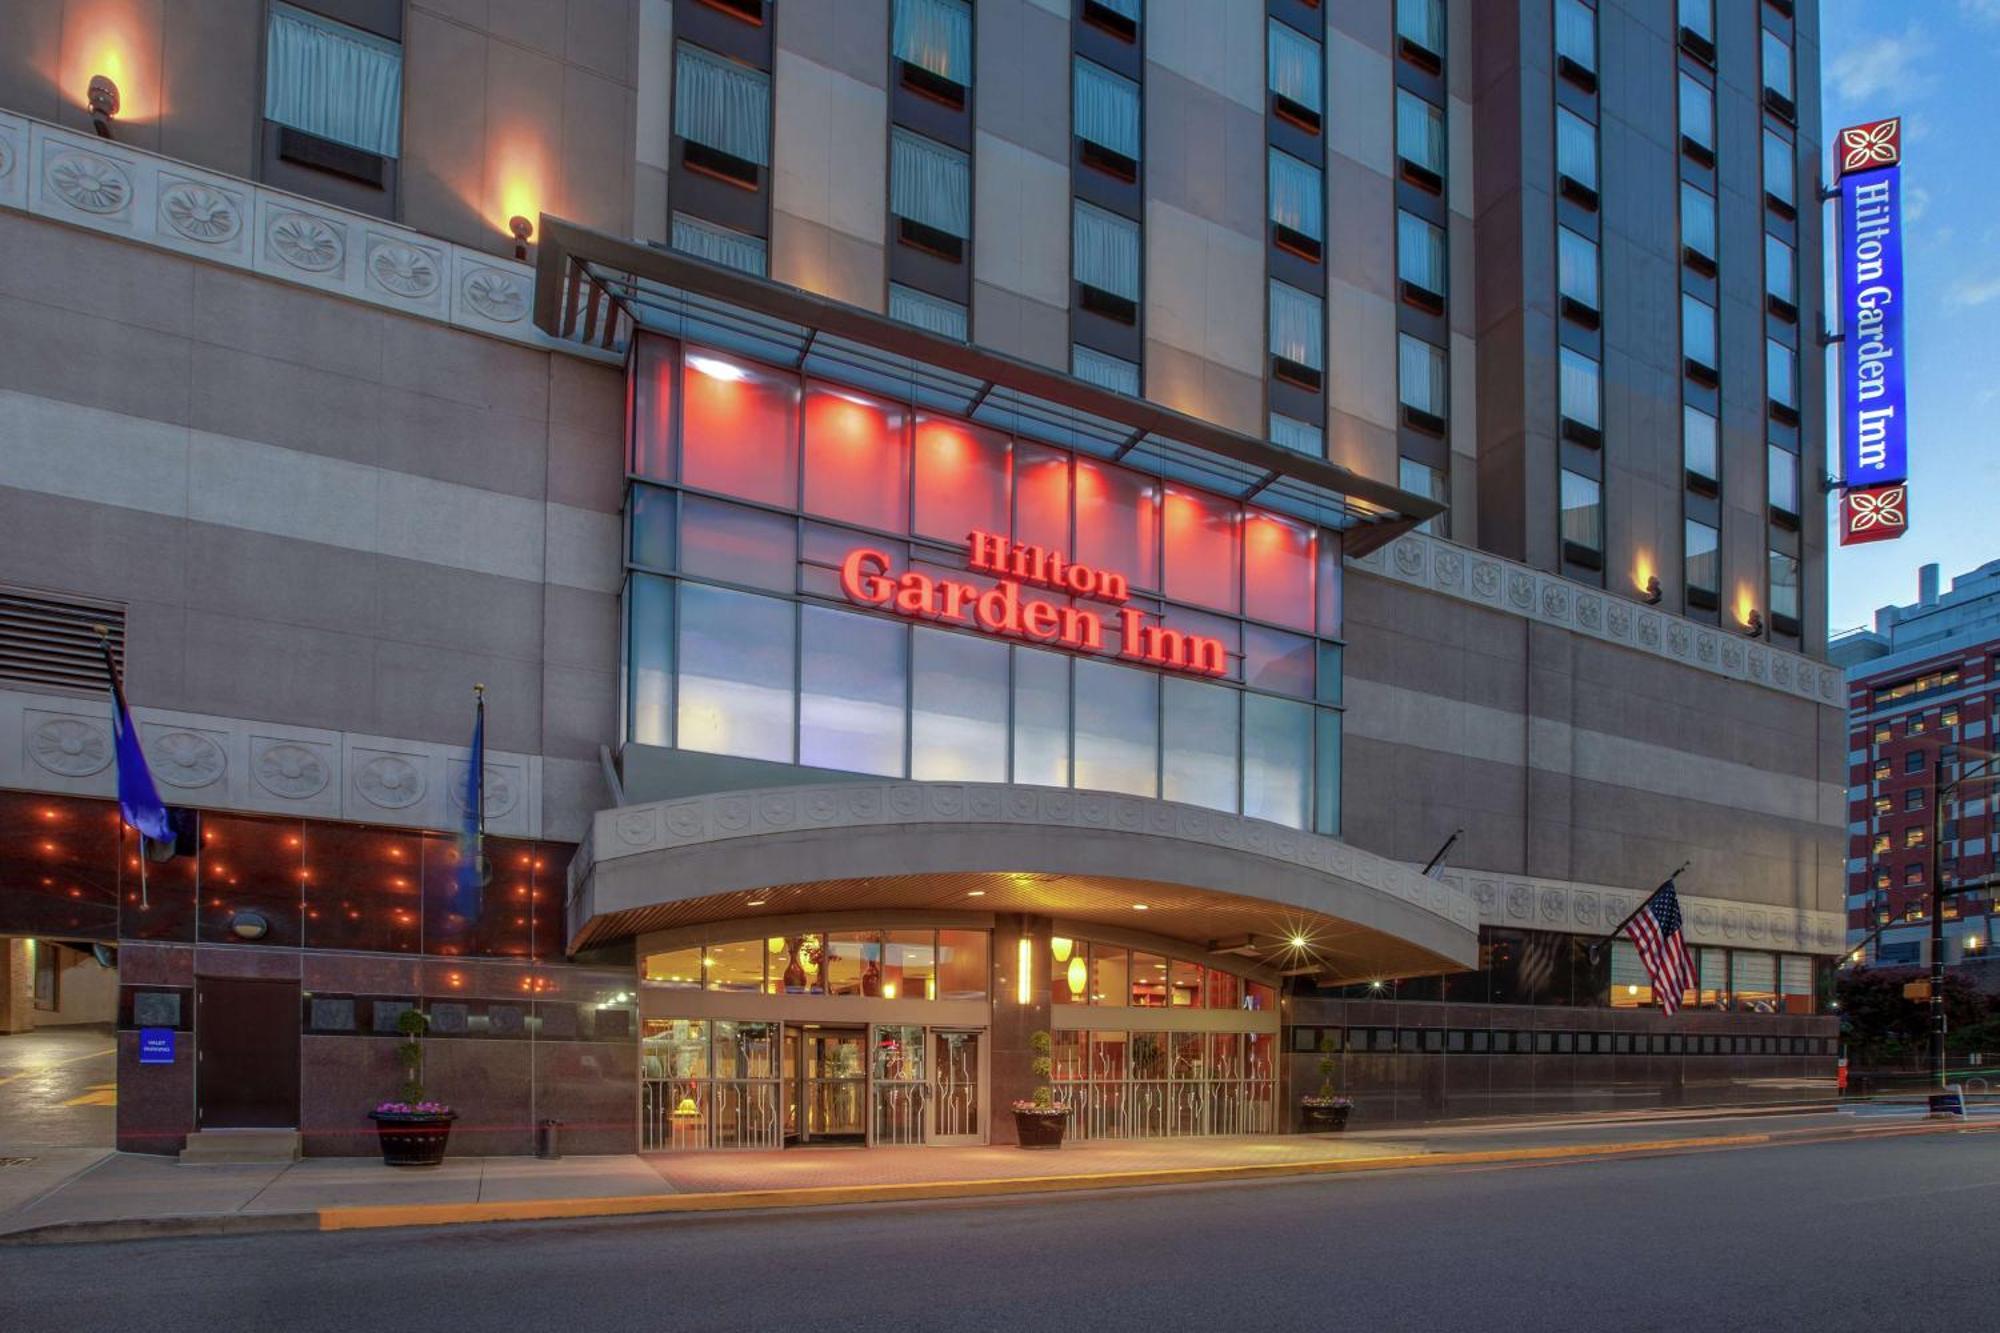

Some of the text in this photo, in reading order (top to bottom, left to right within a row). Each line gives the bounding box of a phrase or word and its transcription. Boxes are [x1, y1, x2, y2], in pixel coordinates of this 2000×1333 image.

[1855, 180, 1894, 468] Hilton Garden Inn
[840, 548, 1228, 676] Garden Inn
[967, 530, 1129, 604] Hilton
